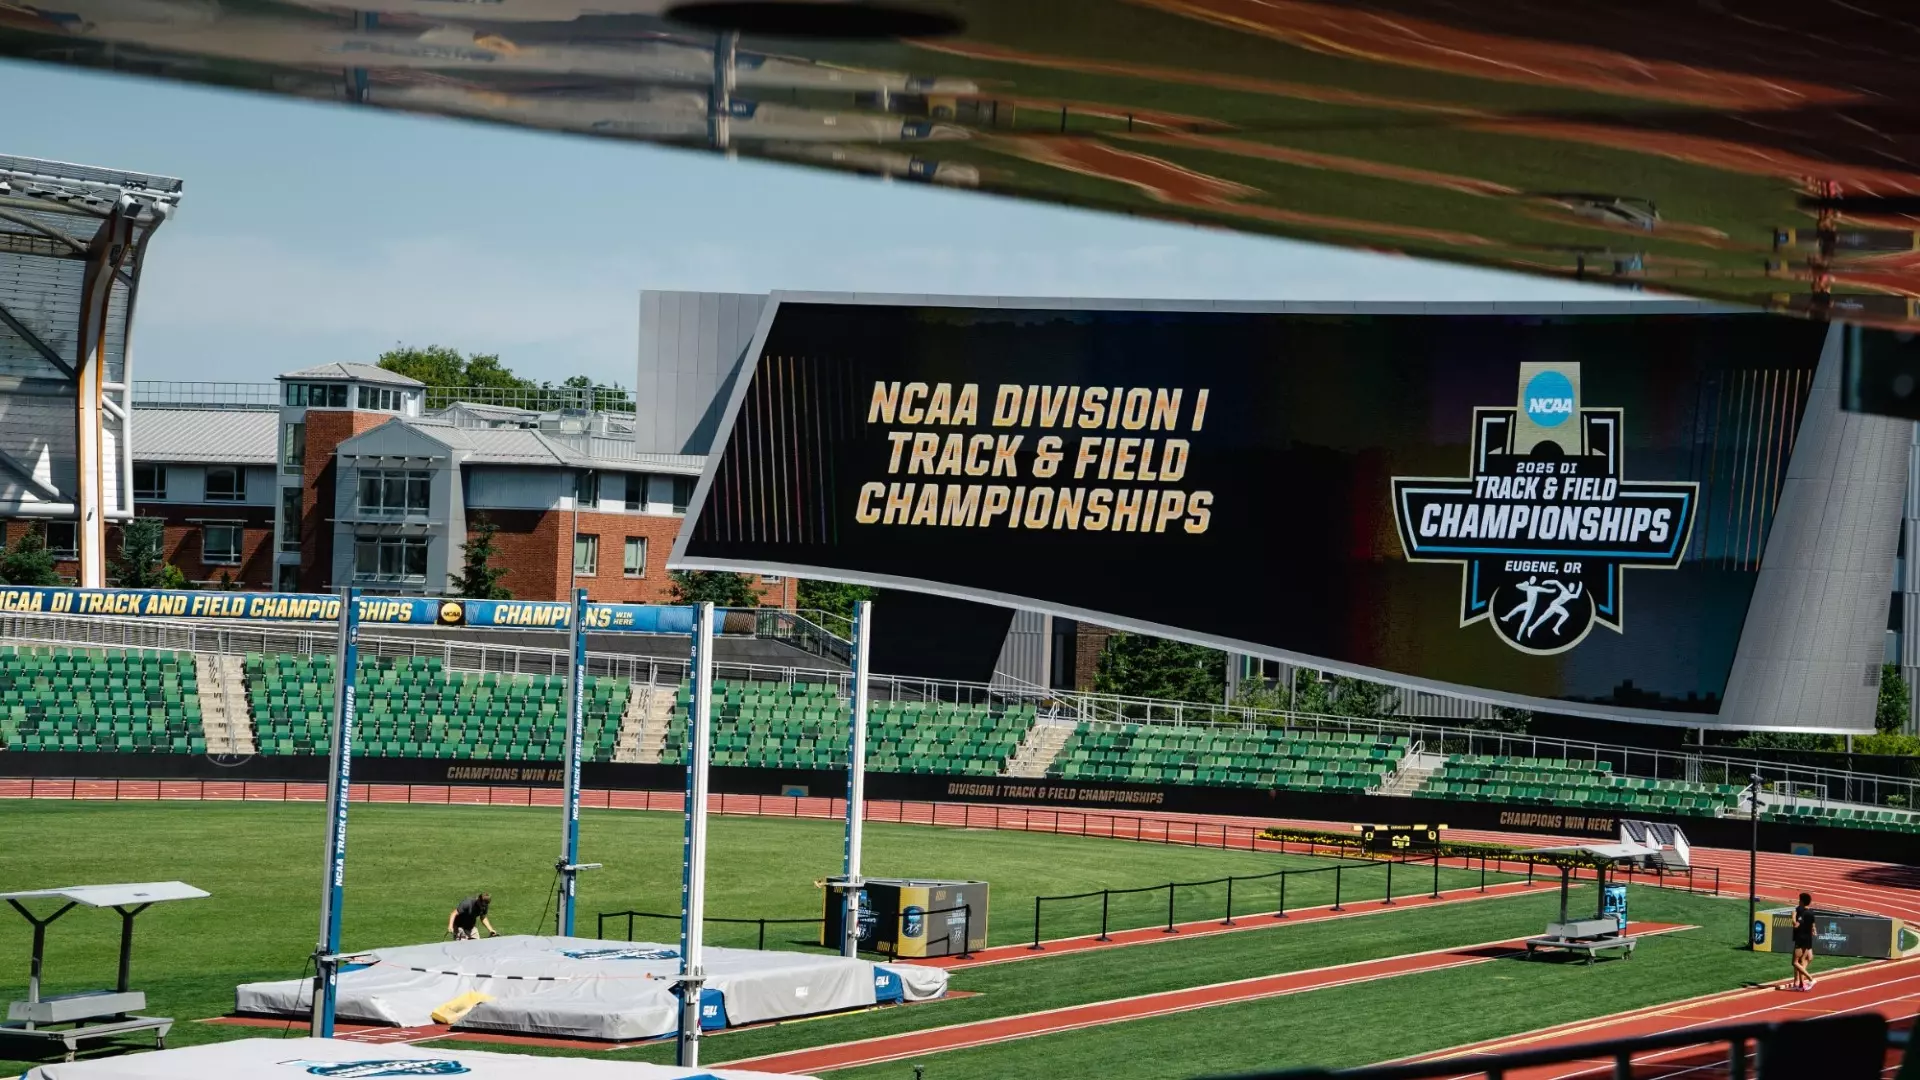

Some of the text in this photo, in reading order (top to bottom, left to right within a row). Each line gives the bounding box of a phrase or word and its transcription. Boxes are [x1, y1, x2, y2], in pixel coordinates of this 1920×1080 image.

[867, 381, 1209, 431] NCAA DIVISION I
[1528, 397, 1573, 413] NCAA
[887, 431, 1190, 482] TRACK & FIELD
[1516, 462, 1577, 474] 2025 DI
[1475, 476, 1617, 501] TRACK & FIELD
[855, 481, 1213, 534] CHAMPIONSHIPS
[1419, 503, 1672, 543] CHAMPIONSHIPS
[1504, 560, 1582, 574] EUGENE, OR
[51, 592, 74, 612] DI
[79, 593, 144, 614] TRACK
[145, 595, 188, 615] AND
[191, 596, 246, 617] FIELD
[249, 598, 413, 621] CHAMPIOSHIPS
[493, 604, 612, 628] CHAMPINS
[576, 665, 584, 735] CHAMPIONSHIPS
[342, 685, 355, 777] CHAMPIONSHIPS
[447, 766, 565, 781] CHAMPIONS WIN HE
[340, 779, 349, 808] FIELD
[948, 783, 1164, 804] DIVISION I TRACK & FIELD CHAMPIONSHIPS
[1500, 811, 1614, 832] CHAMPIONS WIN HERE
[337, 820, 346, 854] TRACK
[335, 858, 344, 886] NCAA
